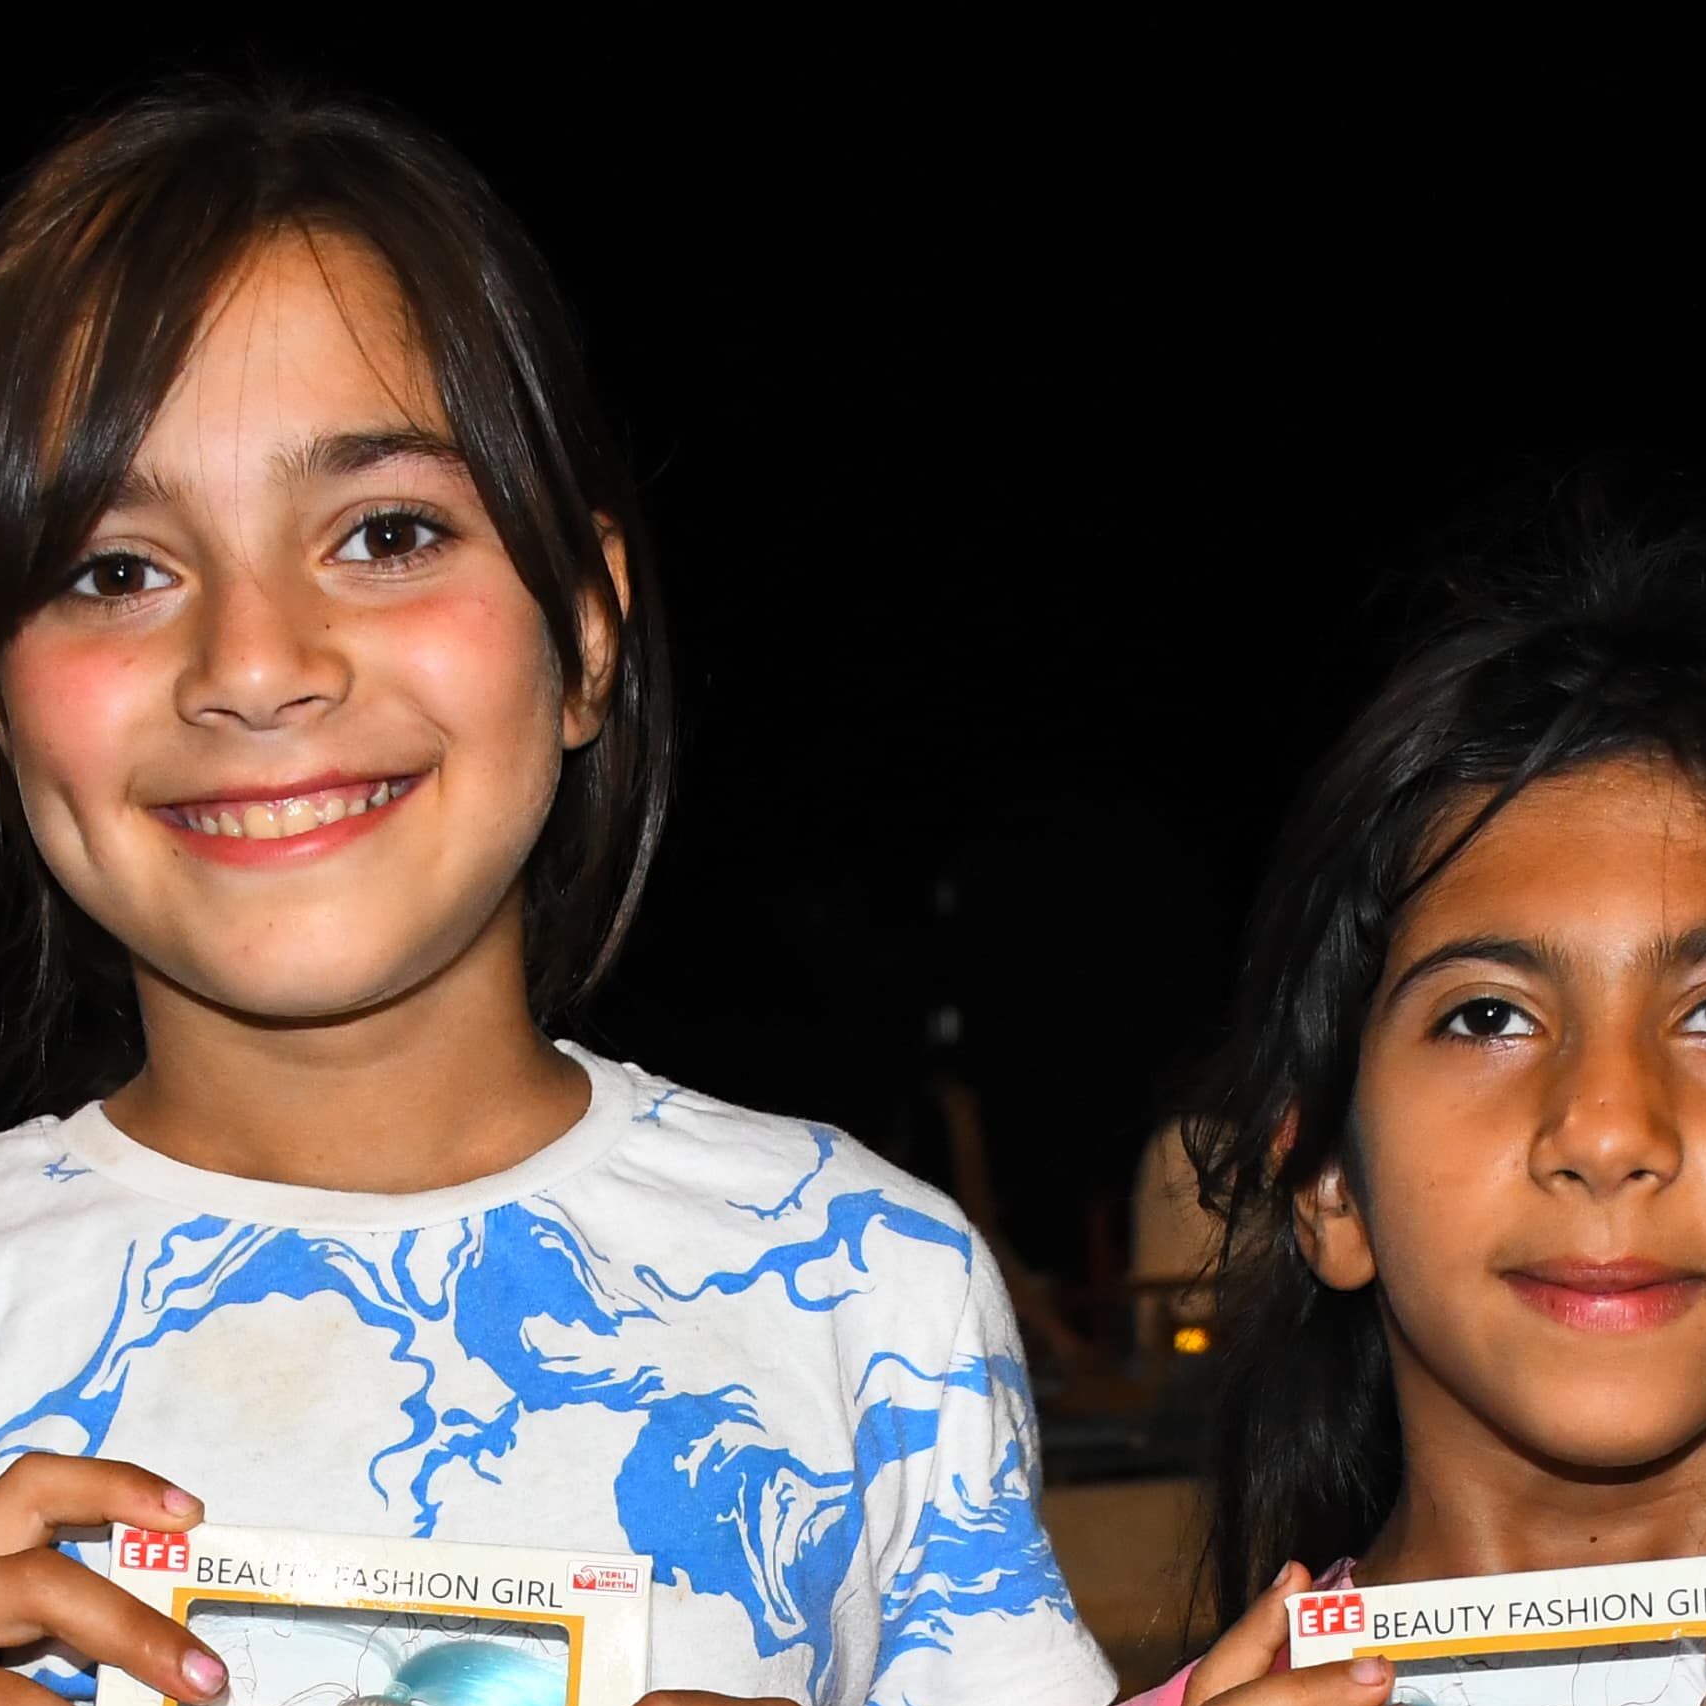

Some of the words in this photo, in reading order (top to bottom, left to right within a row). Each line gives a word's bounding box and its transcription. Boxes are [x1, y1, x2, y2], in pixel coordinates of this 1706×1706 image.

[123, 1541, 186, 1569] EFE
[492, 1577, 563, 1608] GIRL
[1301, 1605, 1361, 1635] EFE
[1373, 1603, 1495, 1640] BEAUTY
[1508, 1590, 1654, 1629] FASHION
